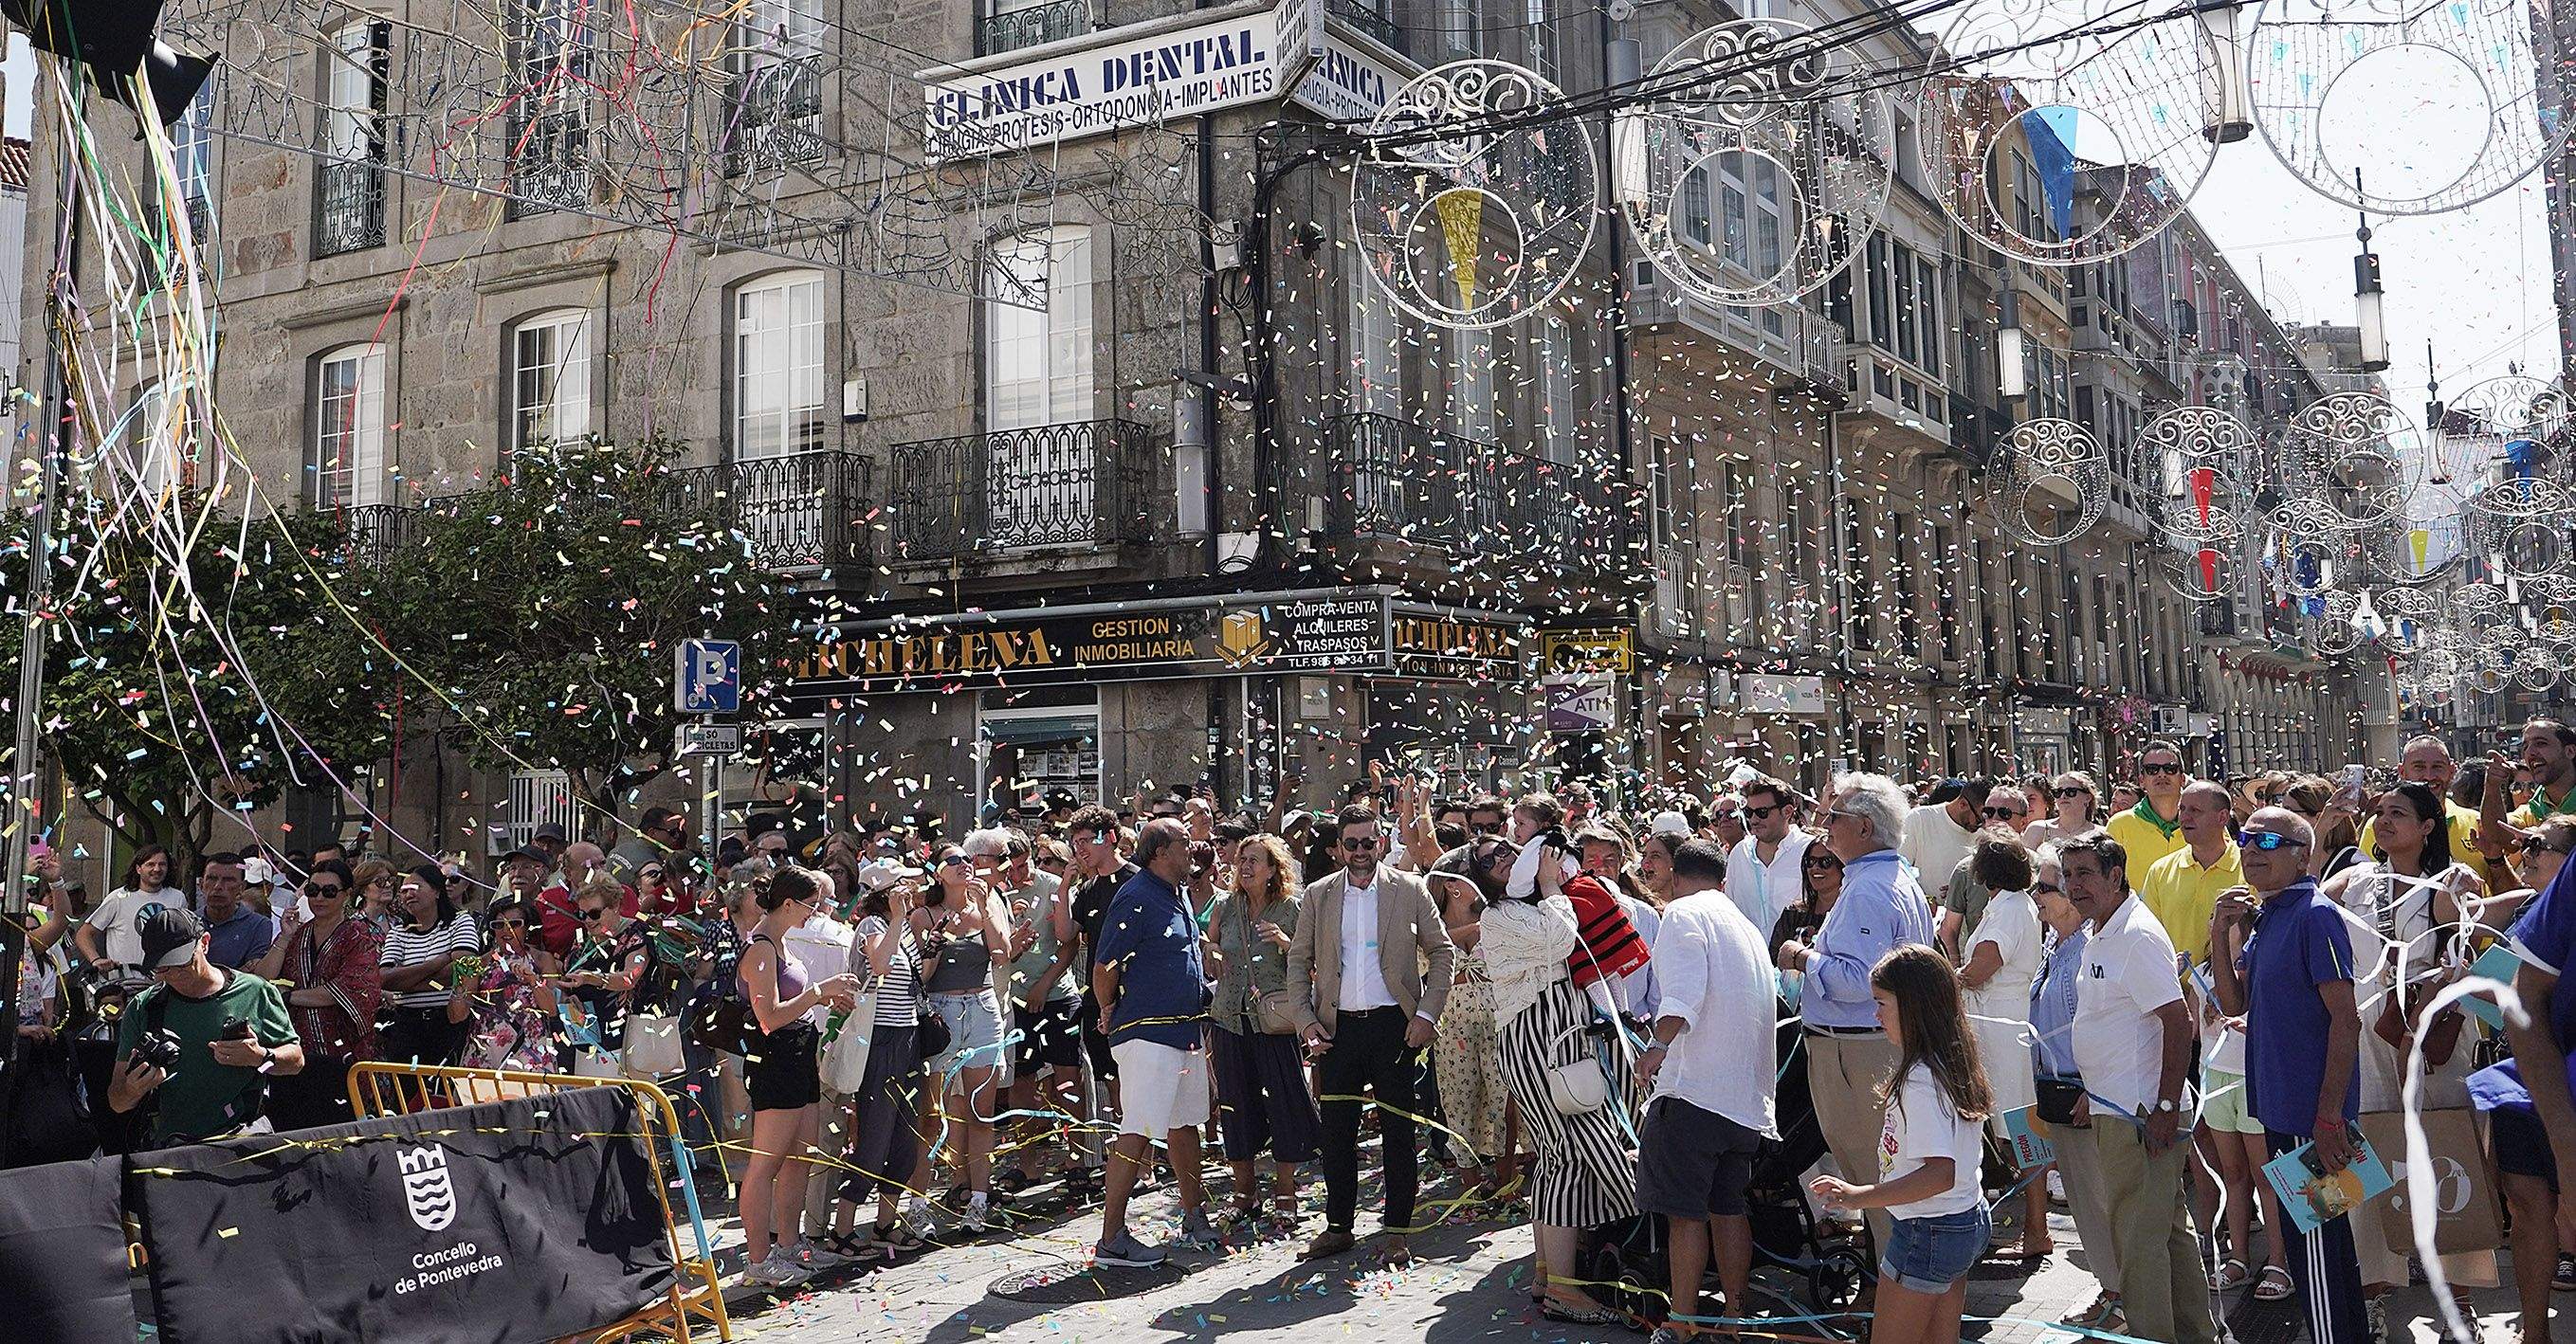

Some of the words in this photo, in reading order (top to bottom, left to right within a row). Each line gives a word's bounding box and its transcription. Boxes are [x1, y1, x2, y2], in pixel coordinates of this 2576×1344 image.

[933, 67, 1081, 126] CLINICA
[1103, 29, 1265, 93] DENTAL
[1312, 46, 1386, 108] INICA
[1285, 600, 1379, 618] COMPRA-VENTA
[1092, 618, 1170, 638] GESTION
[1074, 639, 1196, 662] INMOBILIARIA
[1296, 636, 1368, 653] TRASPASOS
[1350, 655, 1363, 664] 34
[697, 651, 727, 701] P
[411, 1242, 477, 1268] Concello
[394, 1278, 417, 1295] de
[418, 1254, 503, 1288] Pontevedra
